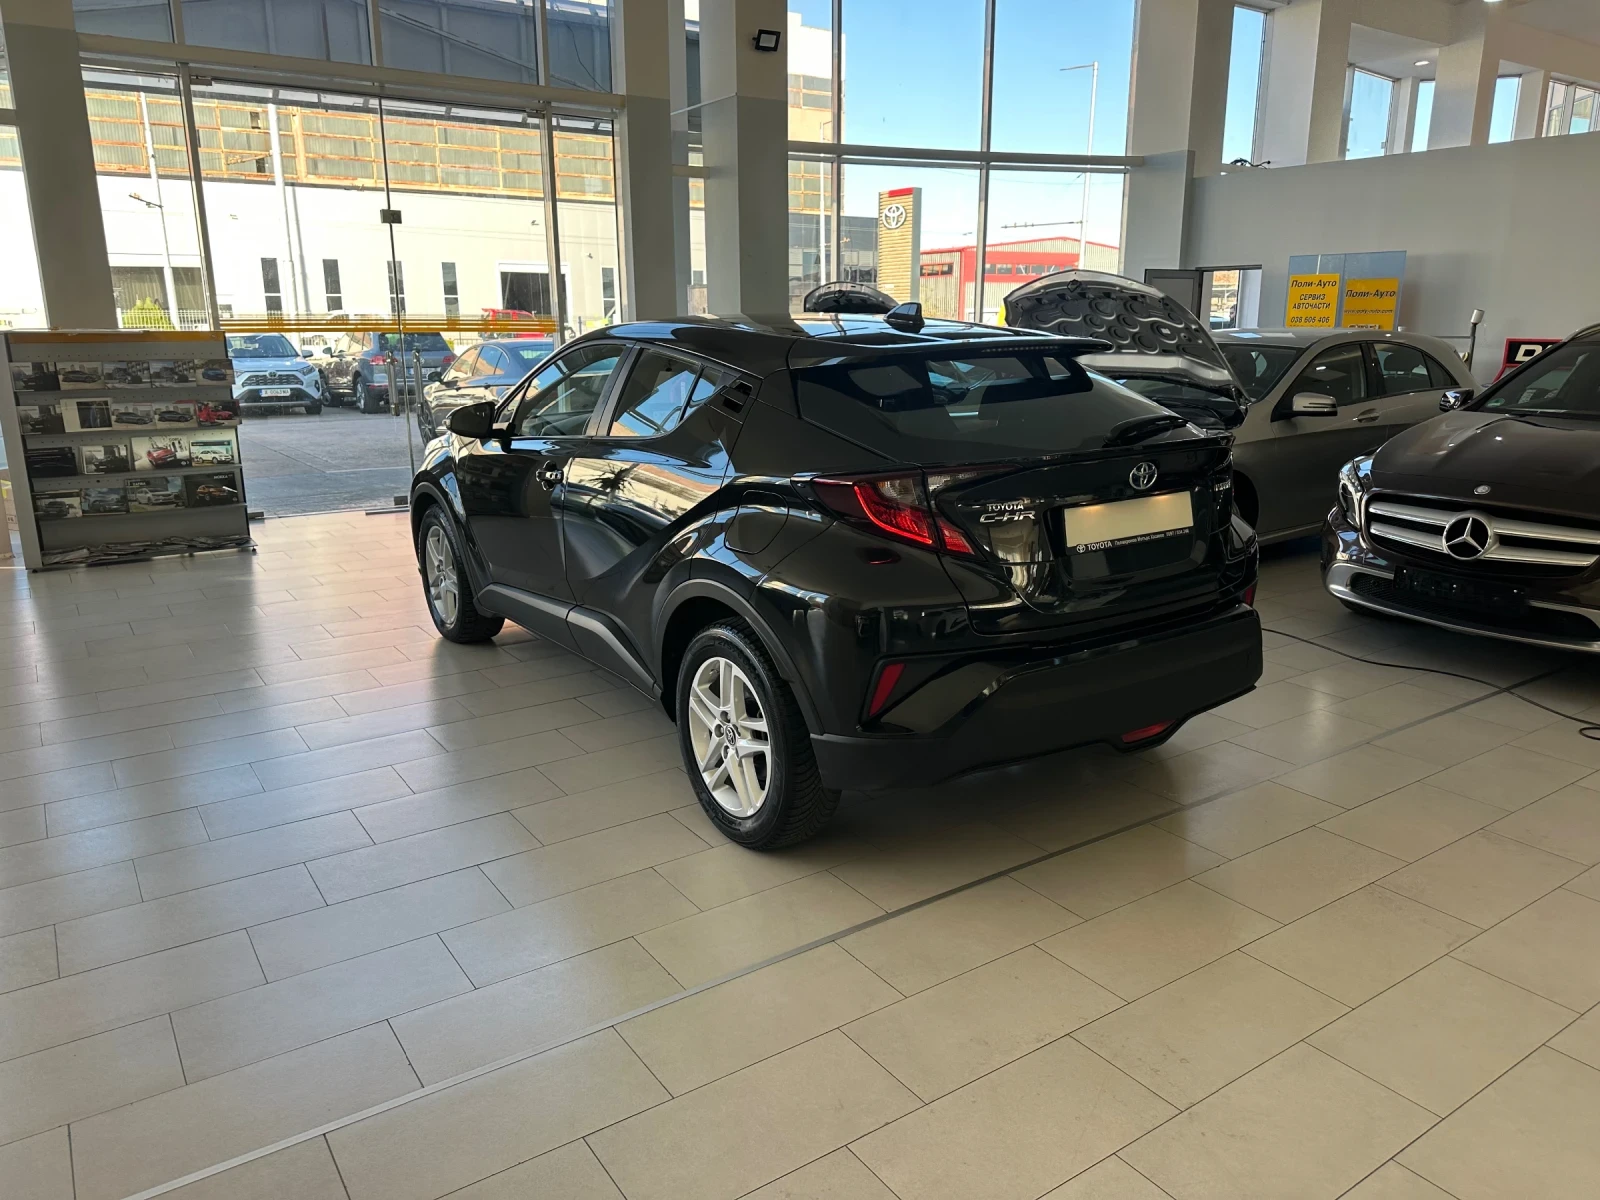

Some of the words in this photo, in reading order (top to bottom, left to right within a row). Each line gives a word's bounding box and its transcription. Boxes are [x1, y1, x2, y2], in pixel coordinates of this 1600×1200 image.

[1291, 280, 1336, 289] Поли-Ауто
[1345, 290, 1396, 300] Поли-Ауто
[986, 503, 1024, 512] TOYOTA
[980, 510, 1036, 523] C-HR
[1087, 541, 1112, 551] TOYOTA
